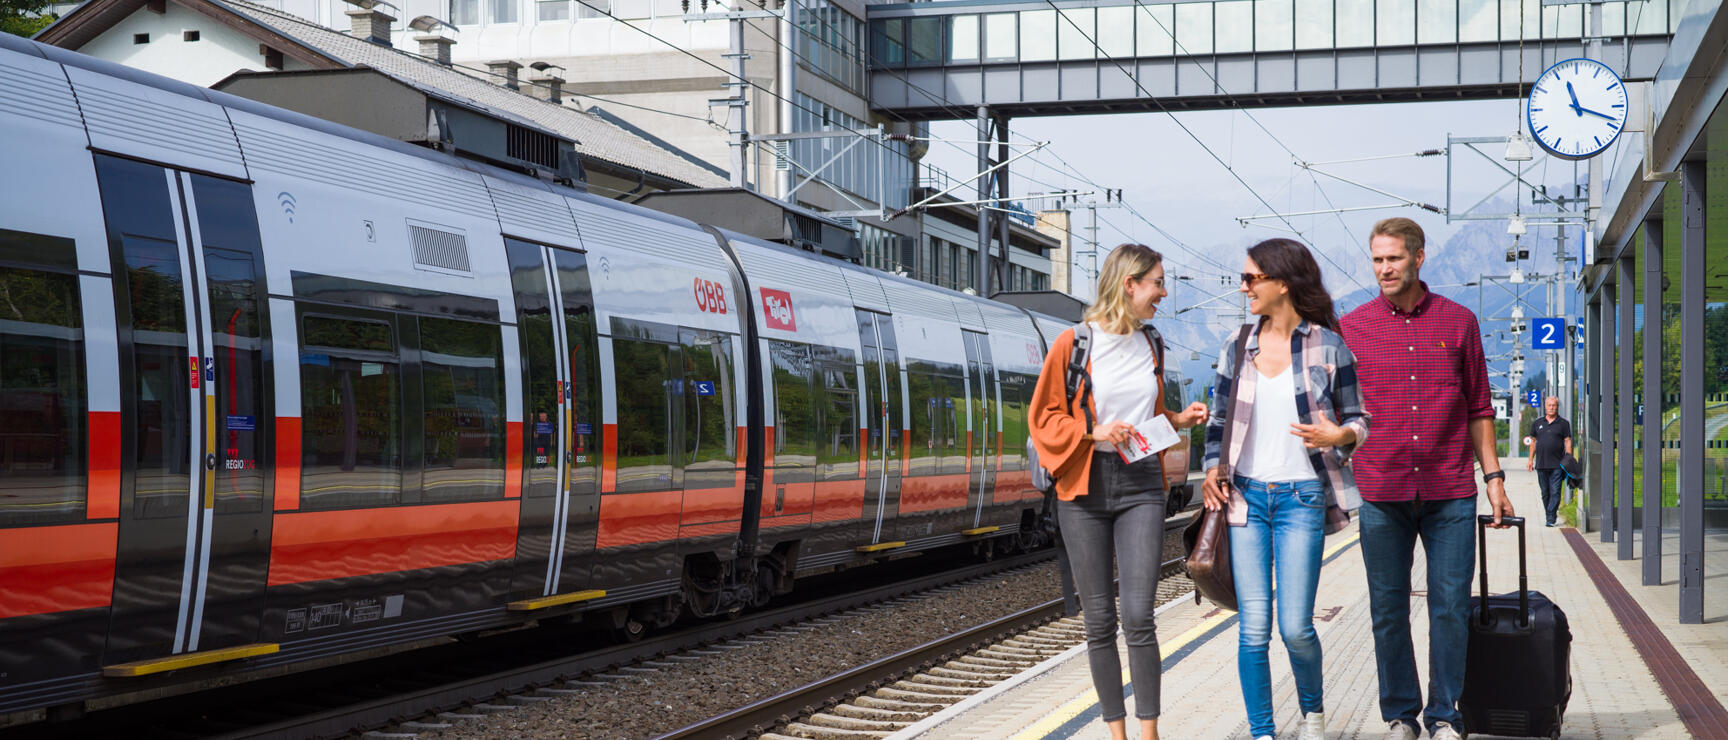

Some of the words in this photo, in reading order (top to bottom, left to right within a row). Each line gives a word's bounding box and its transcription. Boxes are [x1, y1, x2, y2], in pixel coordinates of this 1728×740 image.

[694, 277, 727, 315] ÖBB
[1541, 323, 1555, 344] 2
[1531, 393, 1537, 402] 2
